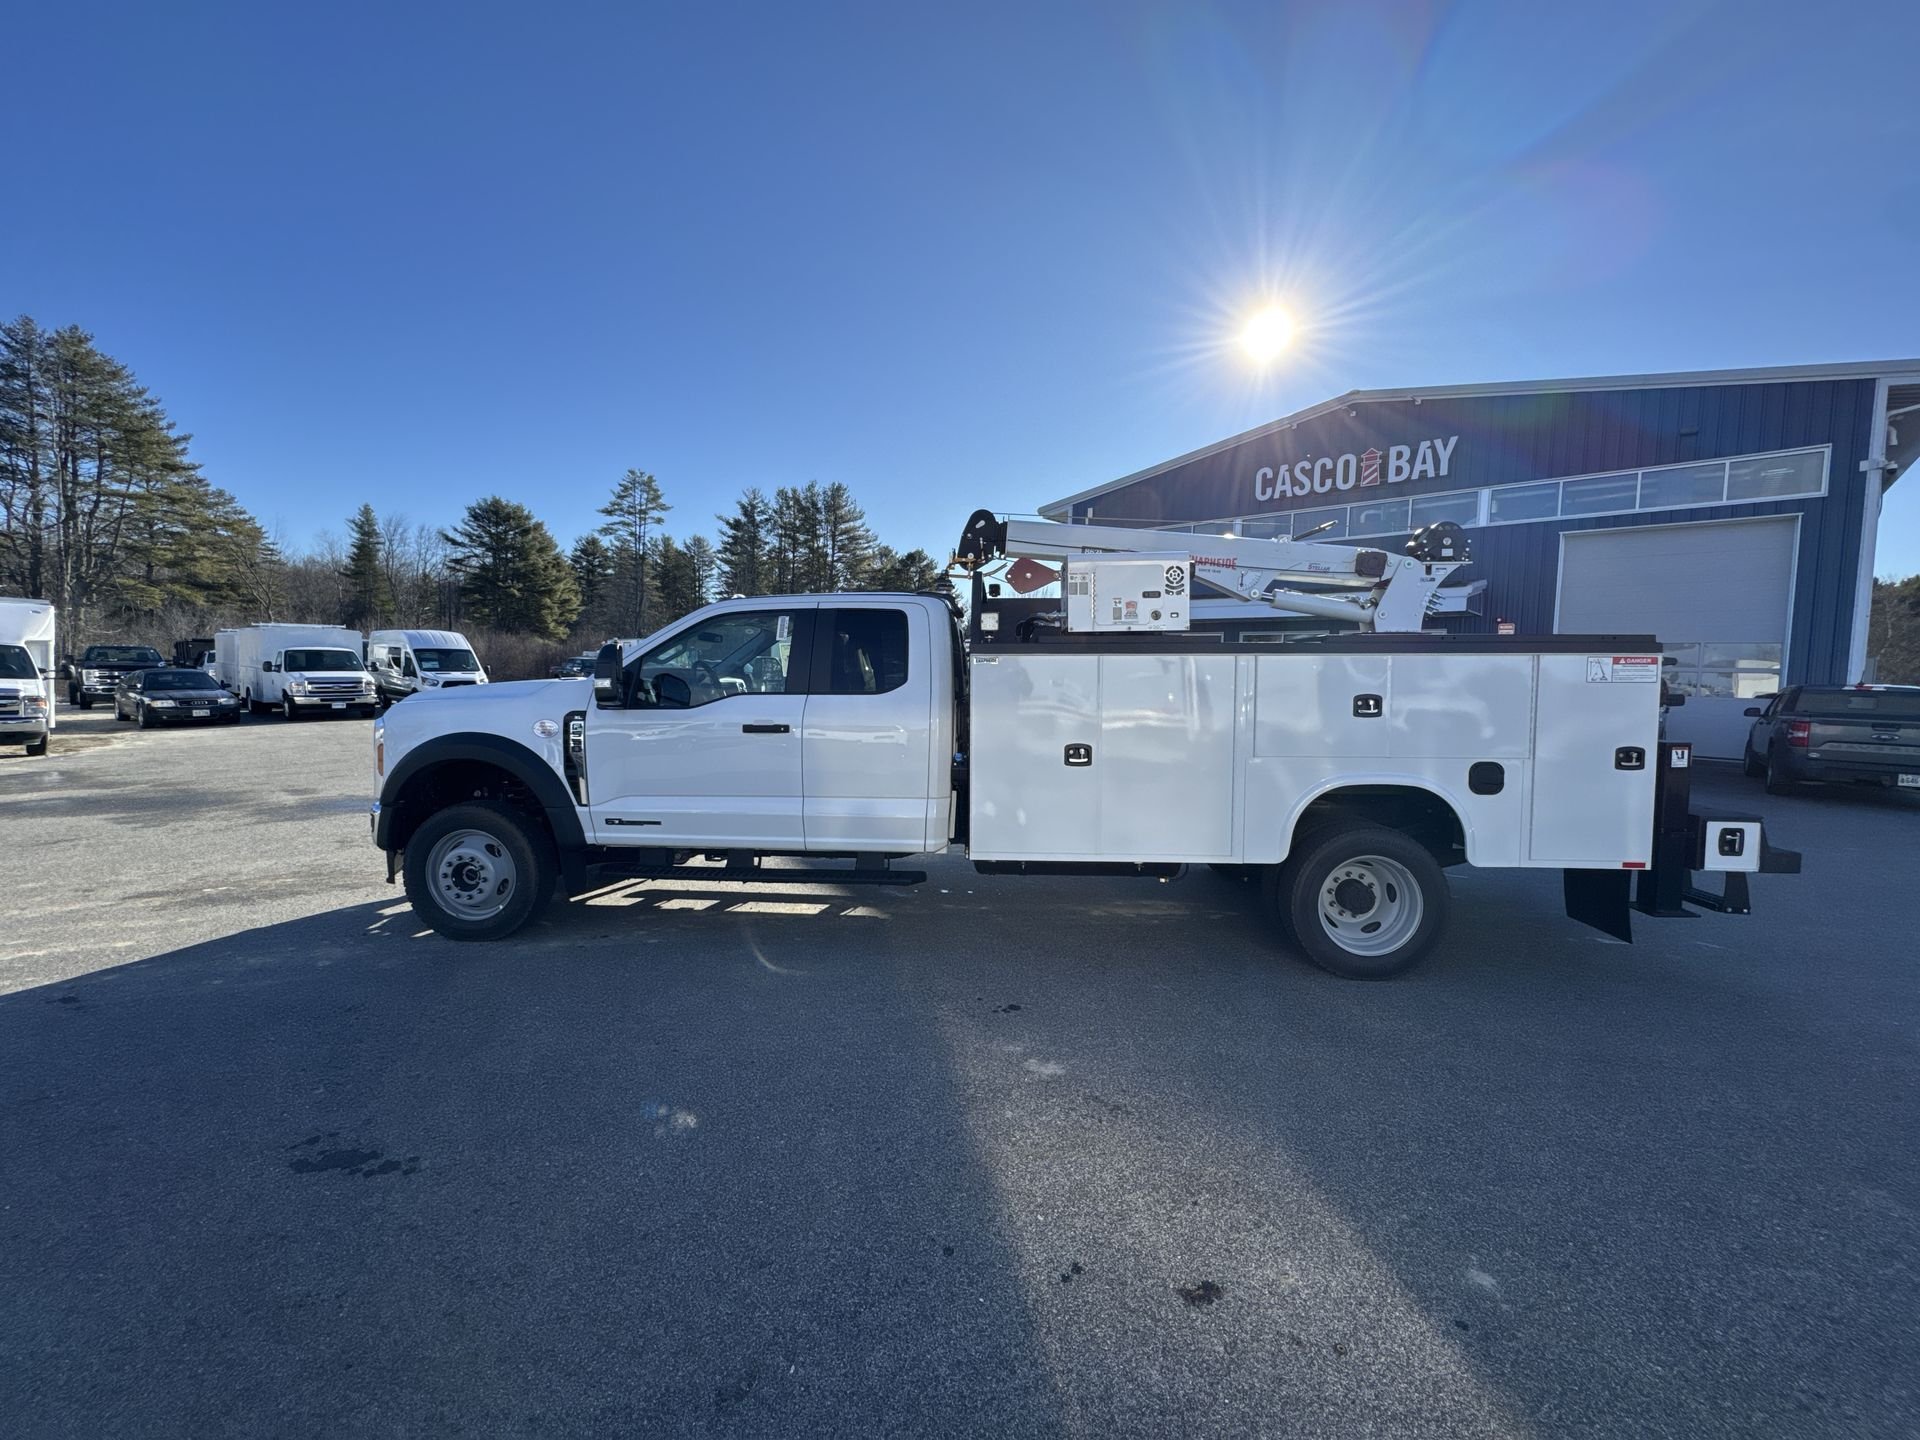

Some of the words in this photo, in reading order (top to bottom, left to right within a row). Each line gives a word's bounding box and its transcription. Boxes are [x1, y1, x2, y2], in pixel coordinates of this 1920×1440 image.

[1255, 453, 1357, 501] CASCO
[1387, 435, 1459, 484] BAY
[1190, 555, 1238, 570] NAPHEIDE
